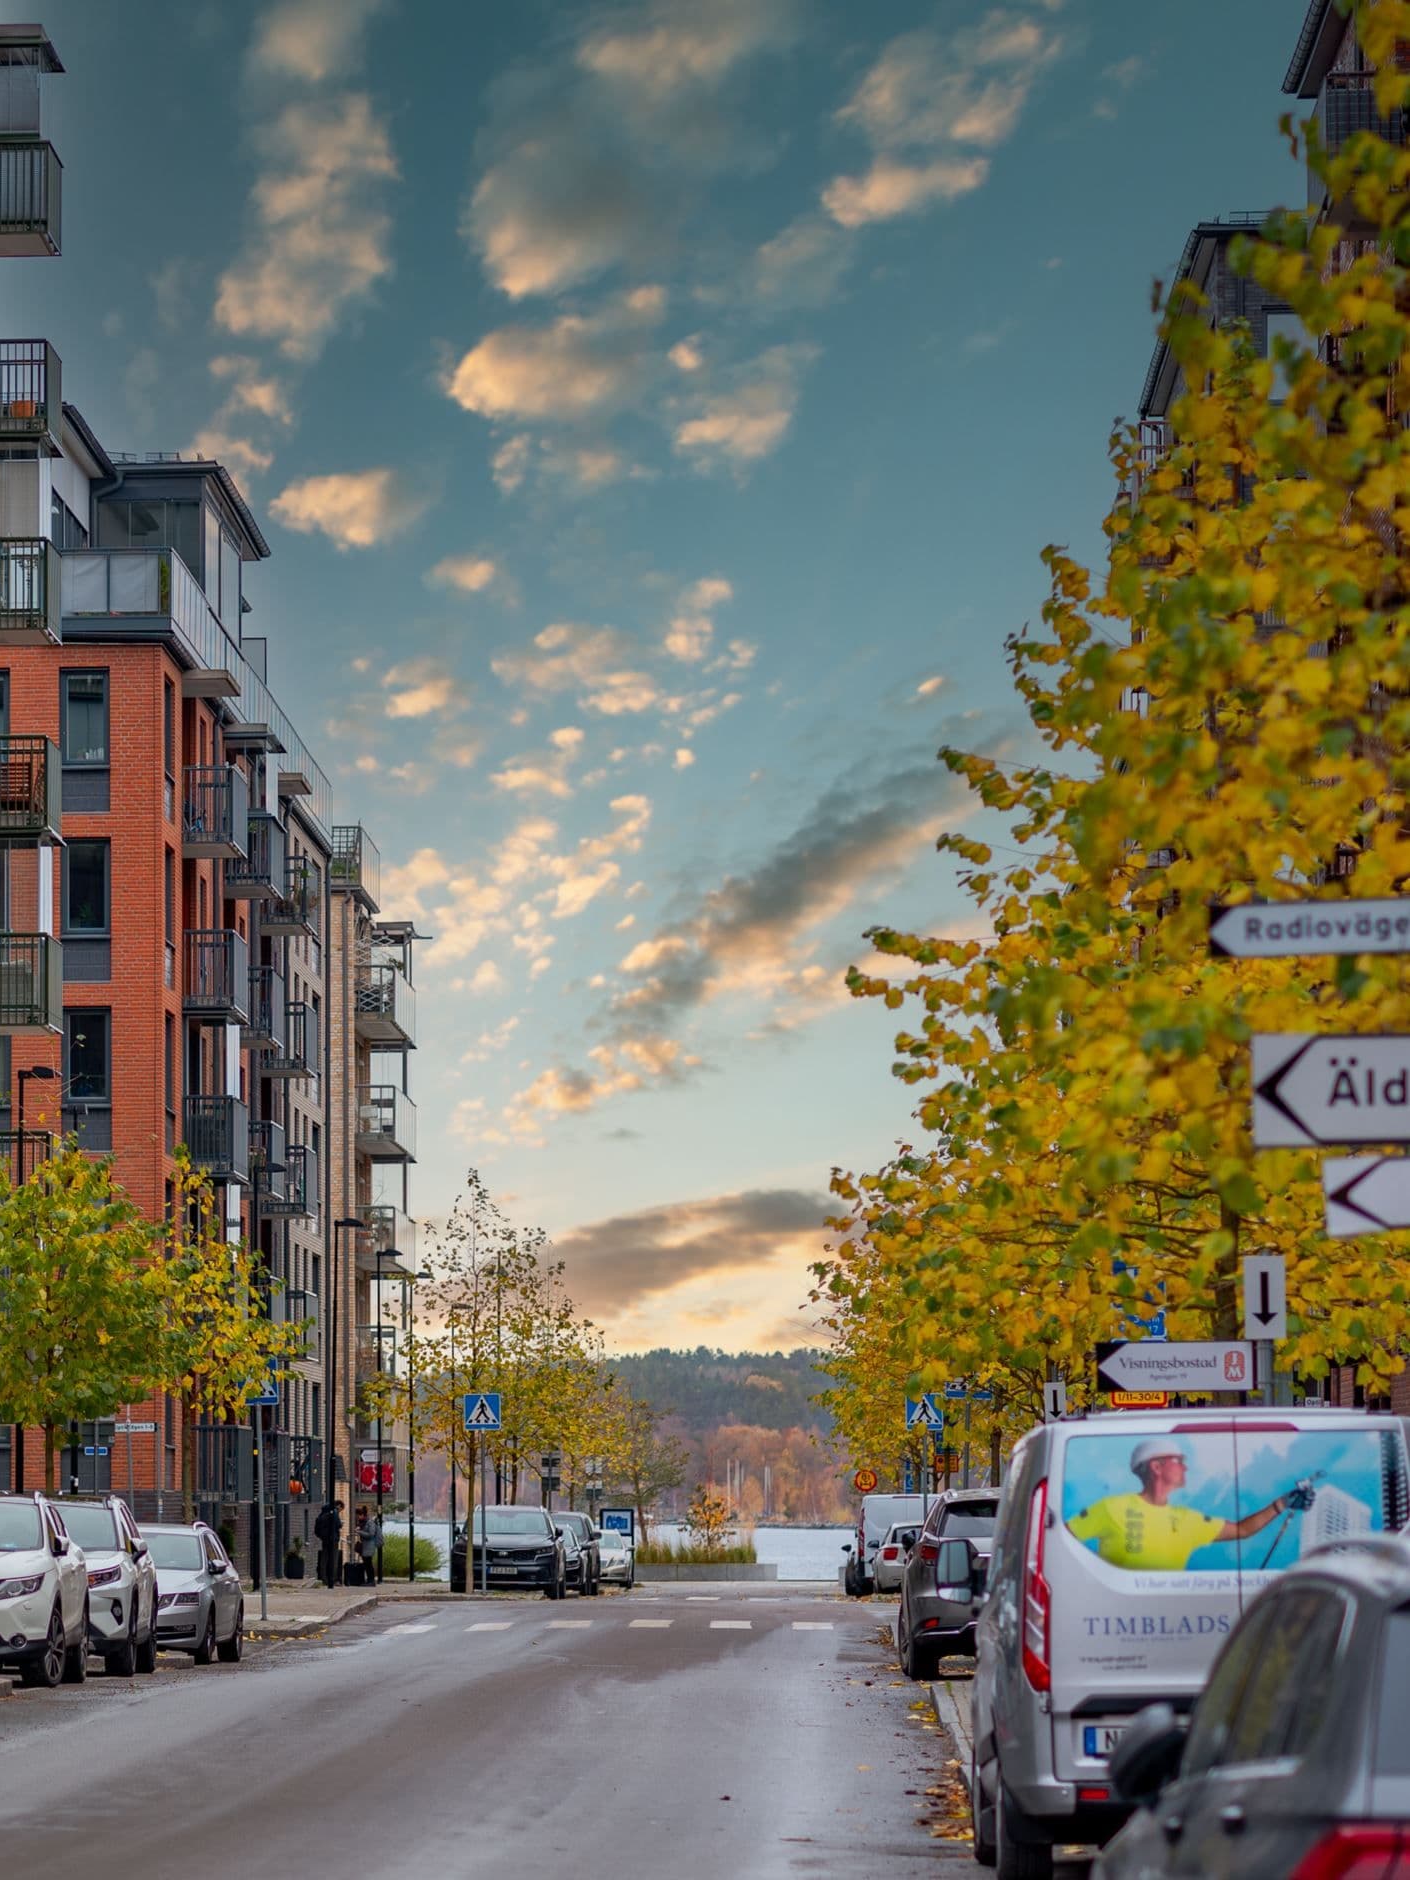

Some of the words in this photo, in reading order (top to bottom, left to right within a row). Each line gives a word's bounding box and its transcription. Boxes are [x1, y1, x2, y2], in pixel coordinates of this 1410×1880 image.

[1327, 1056, 1408, 1107] Äld
[1118, 1354, 1217, 1372] Visningsbostad
[1083, 1614, 1232, 1636] TIMBLADS
